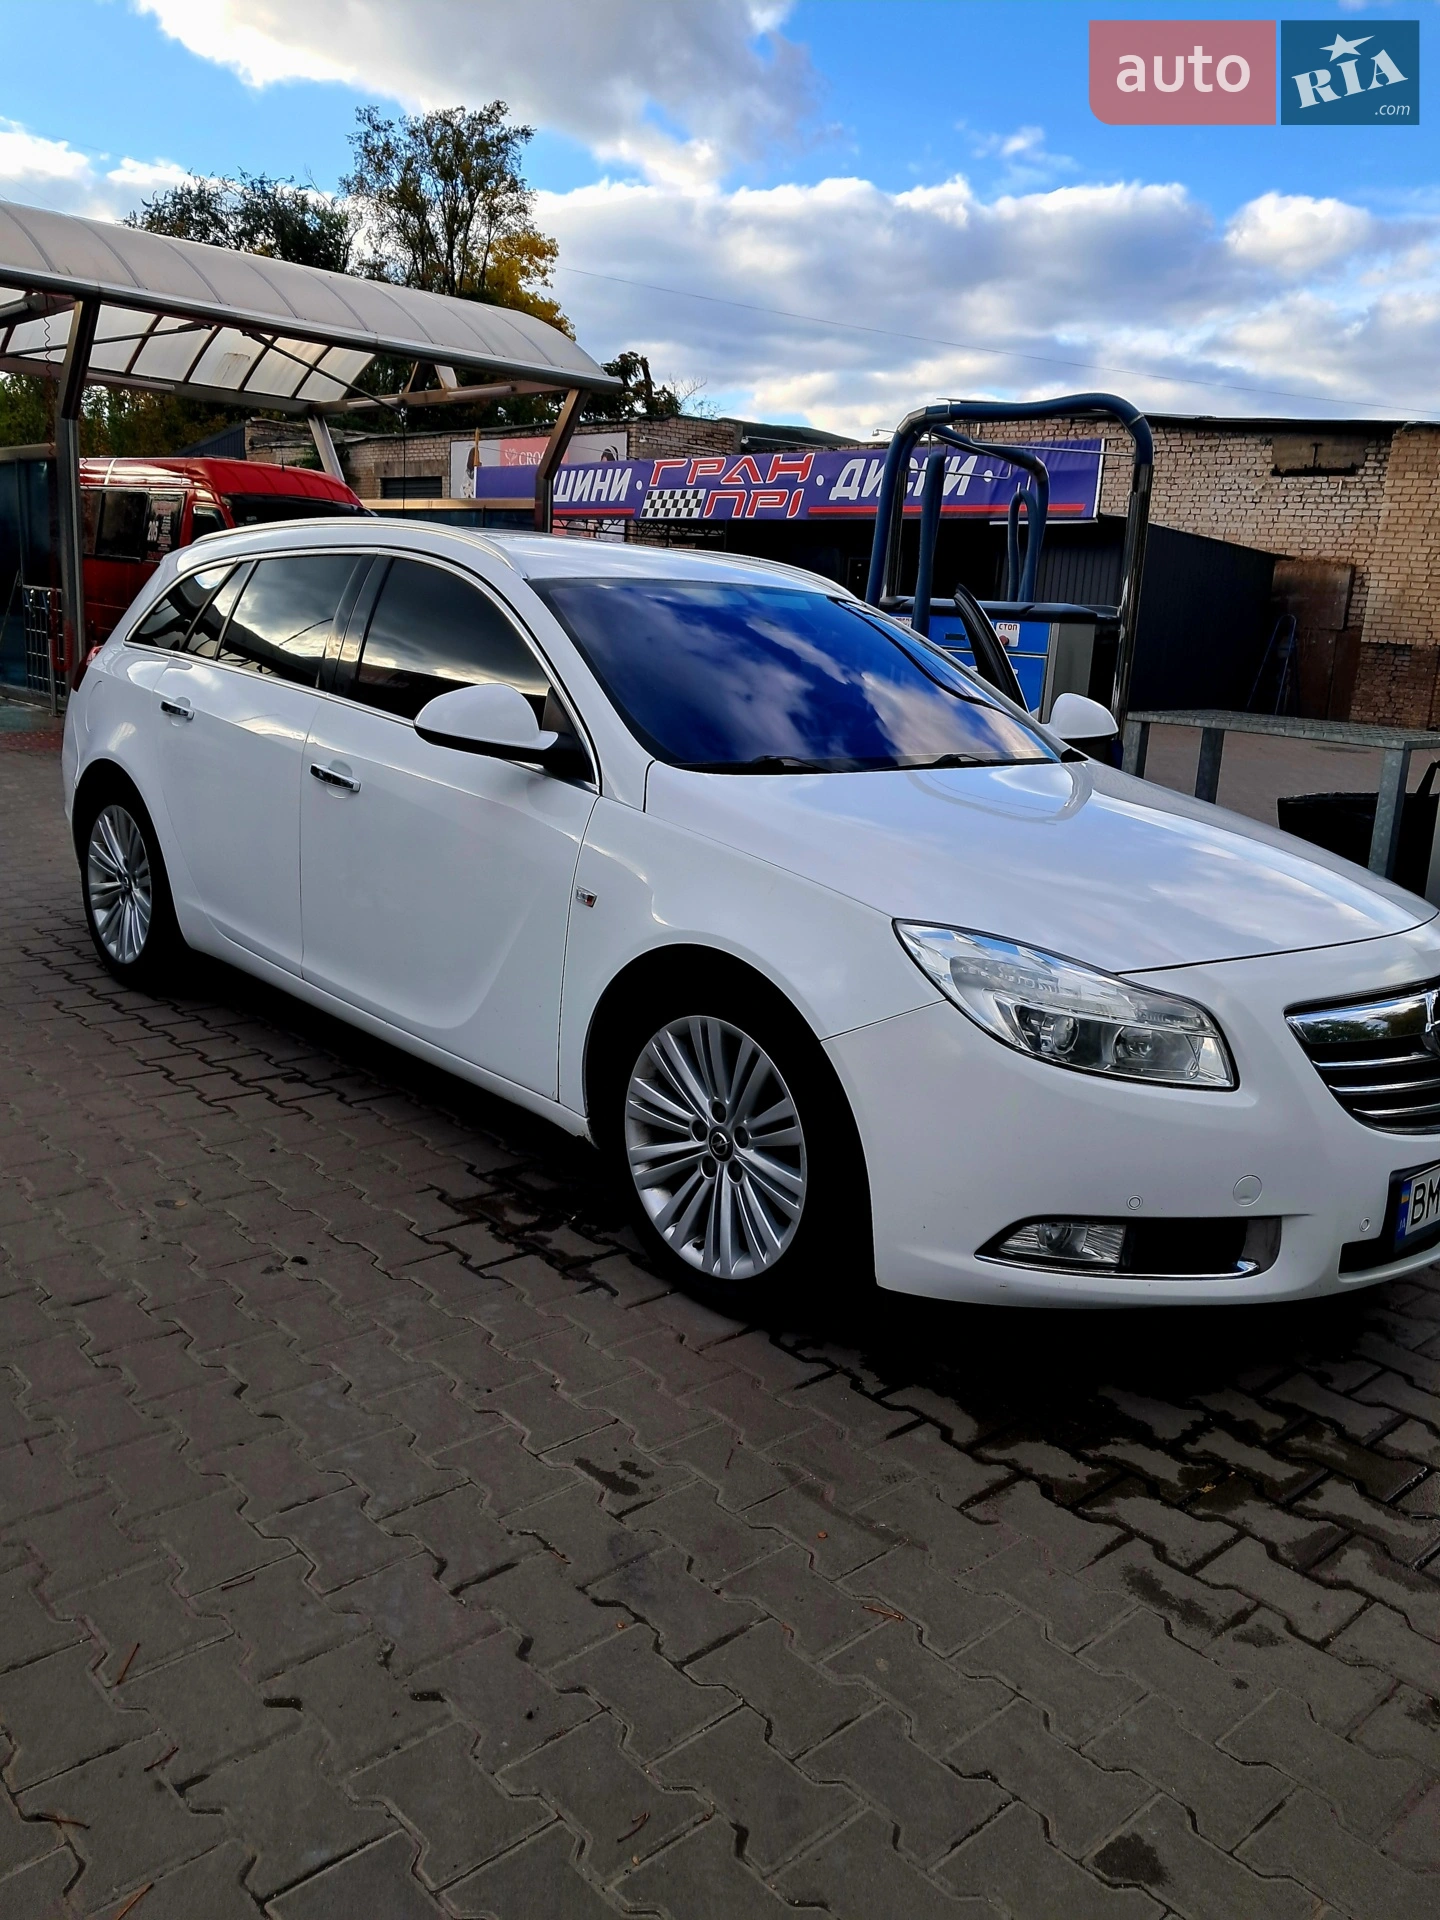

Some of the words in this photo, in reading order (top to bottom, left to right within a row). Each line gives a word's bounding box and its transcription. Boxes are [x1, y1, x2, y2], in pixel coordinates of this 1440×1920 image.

[553, 468, 633, 502] ШИНИ
[649, 453, 815, 487] ГРАН
[999, 623, 1018, 631] СТОП
